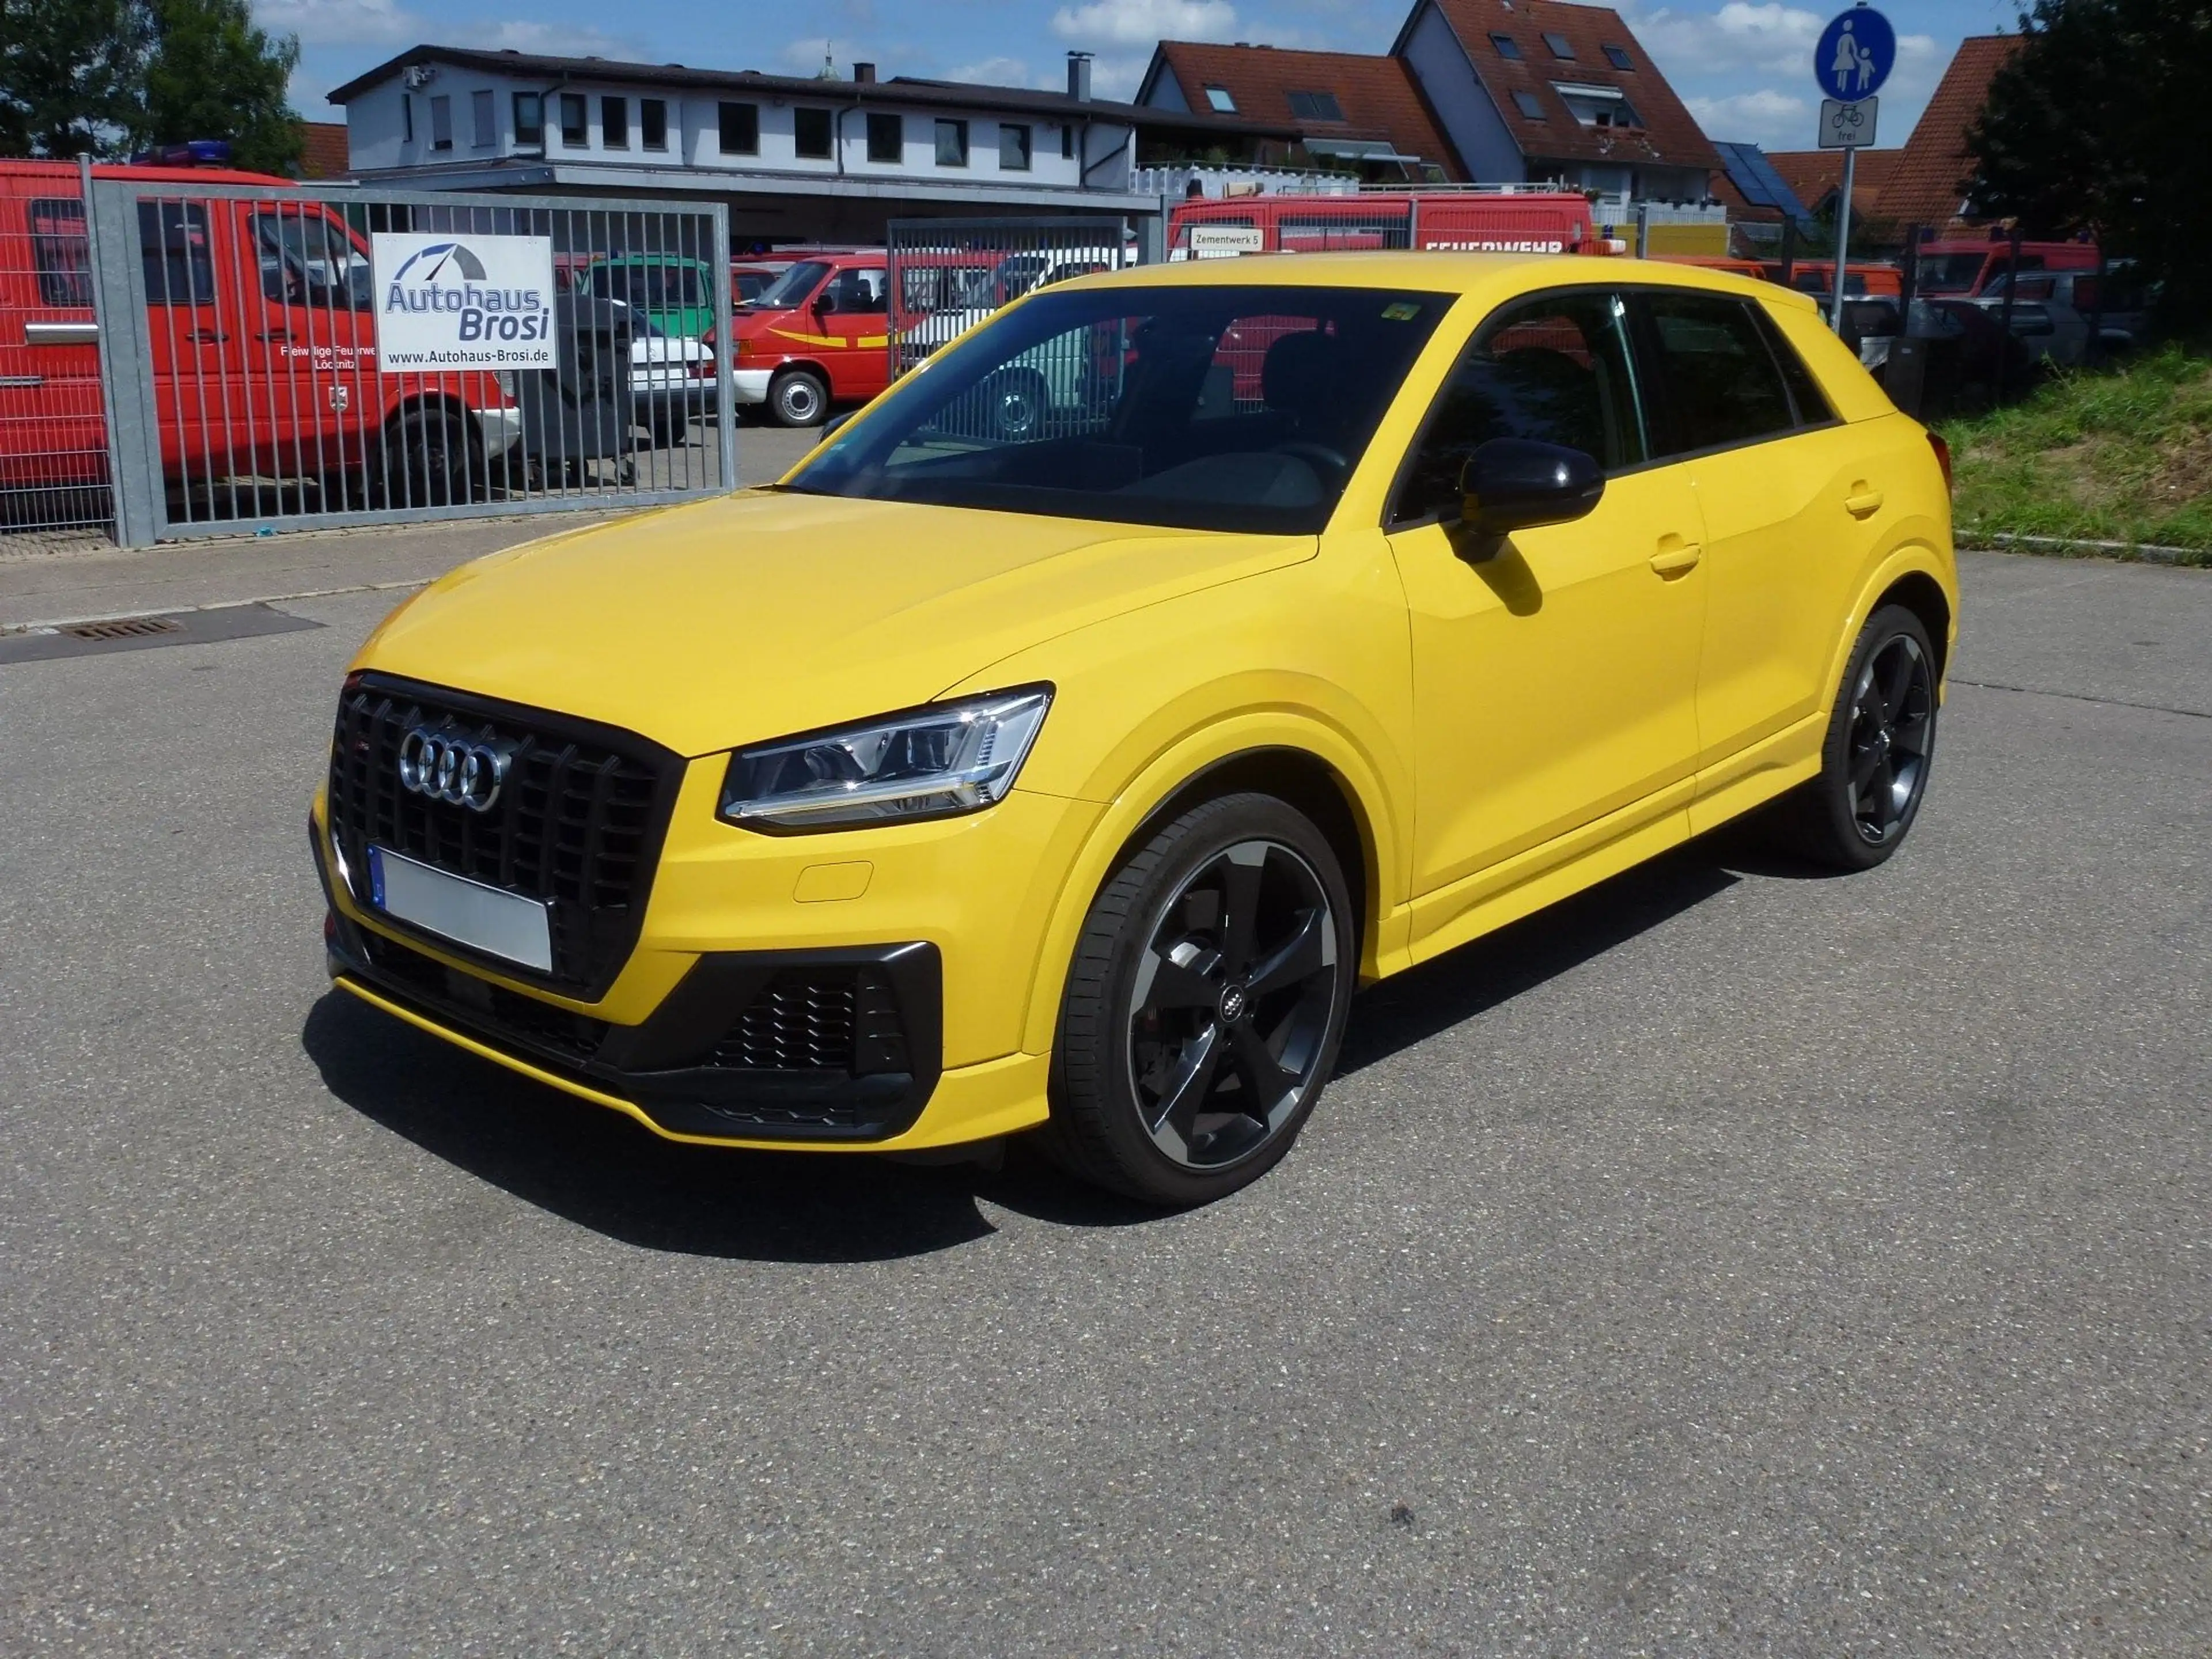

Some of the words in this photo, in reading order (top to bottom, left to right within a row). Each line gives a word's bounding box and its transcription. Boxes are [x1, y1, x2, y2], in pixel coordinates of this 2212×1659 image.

[1838, 130, 1856, 141] frei
[1196, 234, 1251, 244] Zementwerk
[1253, 235, 1259, 245] 5
[386, 283, 541, 314] Autohaus
[459, 308, 550, 341] Brosi
[388, 349, 548, 363] www.Autohaus-Brosi.de
